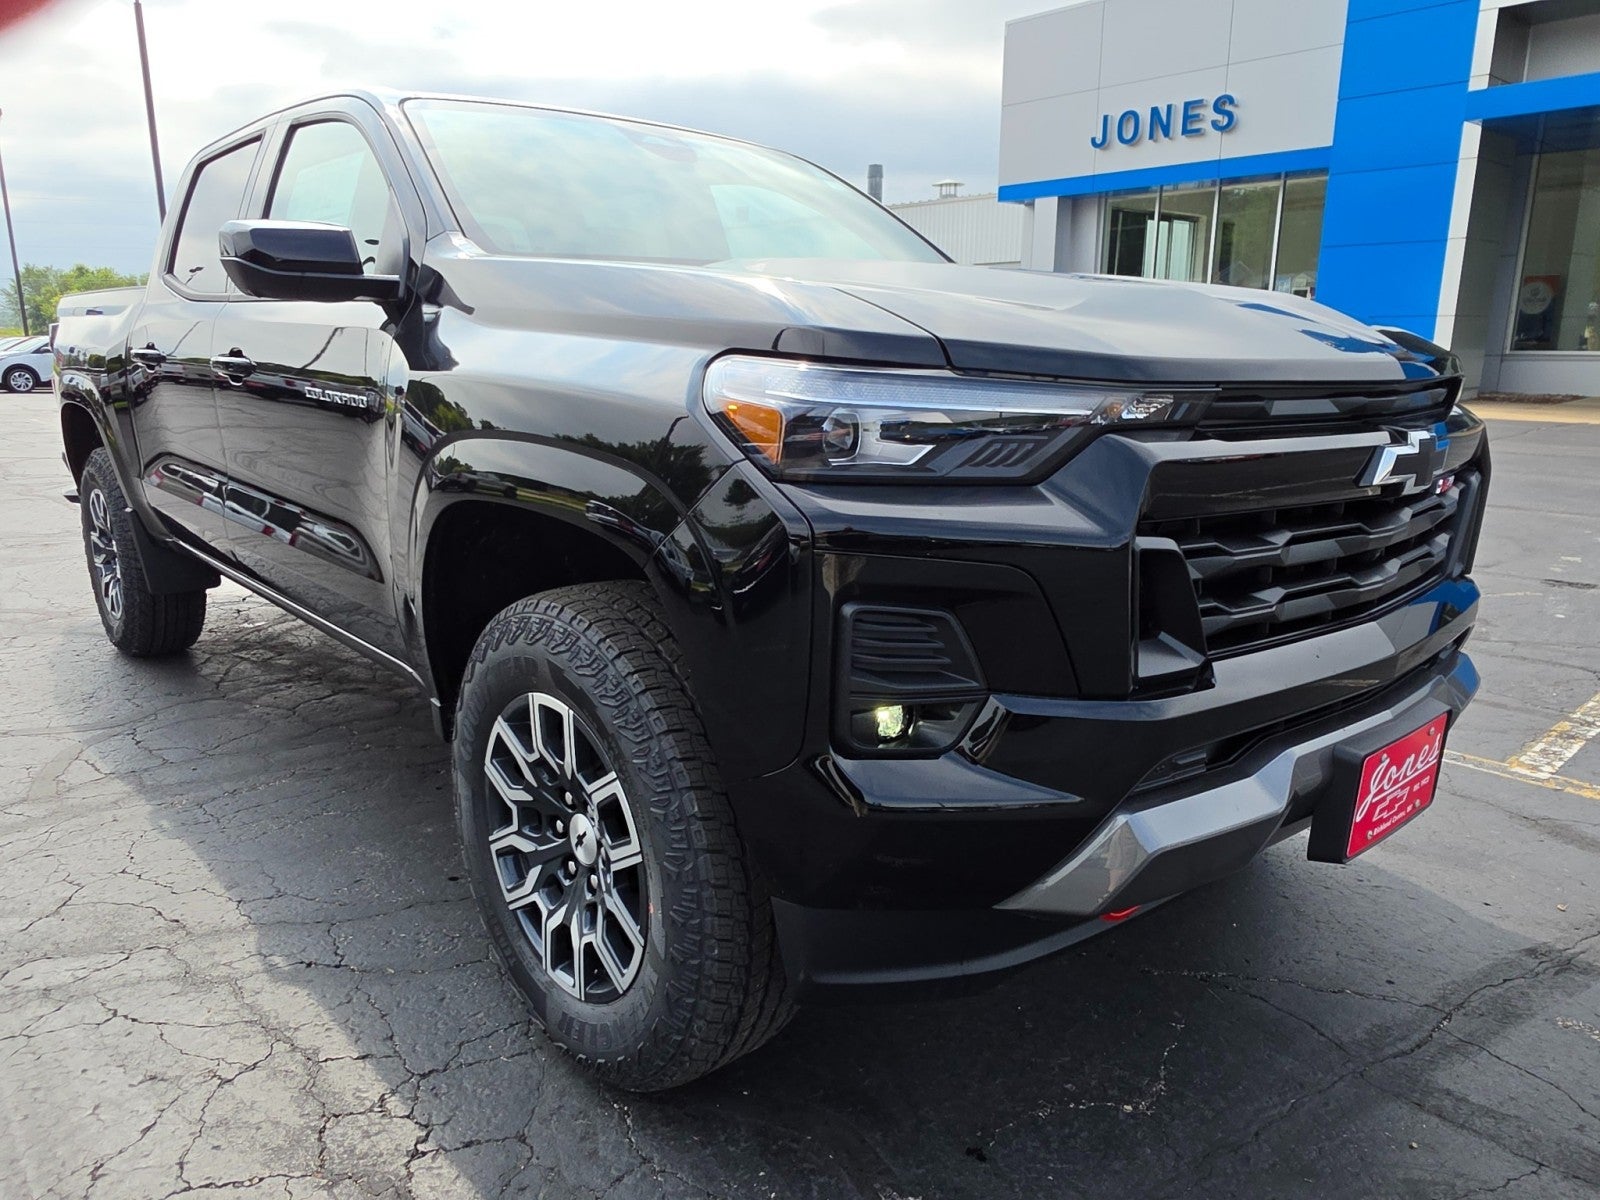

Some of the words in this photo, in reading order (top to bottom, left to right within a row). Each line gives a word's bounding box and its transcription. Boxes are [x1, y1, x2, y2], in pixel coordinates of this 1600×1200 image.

[1090, 93, 1238, 150] JONES
[304, 386, 368, 408] COLORADO
[1356, 733, 1441, 823] Jones
